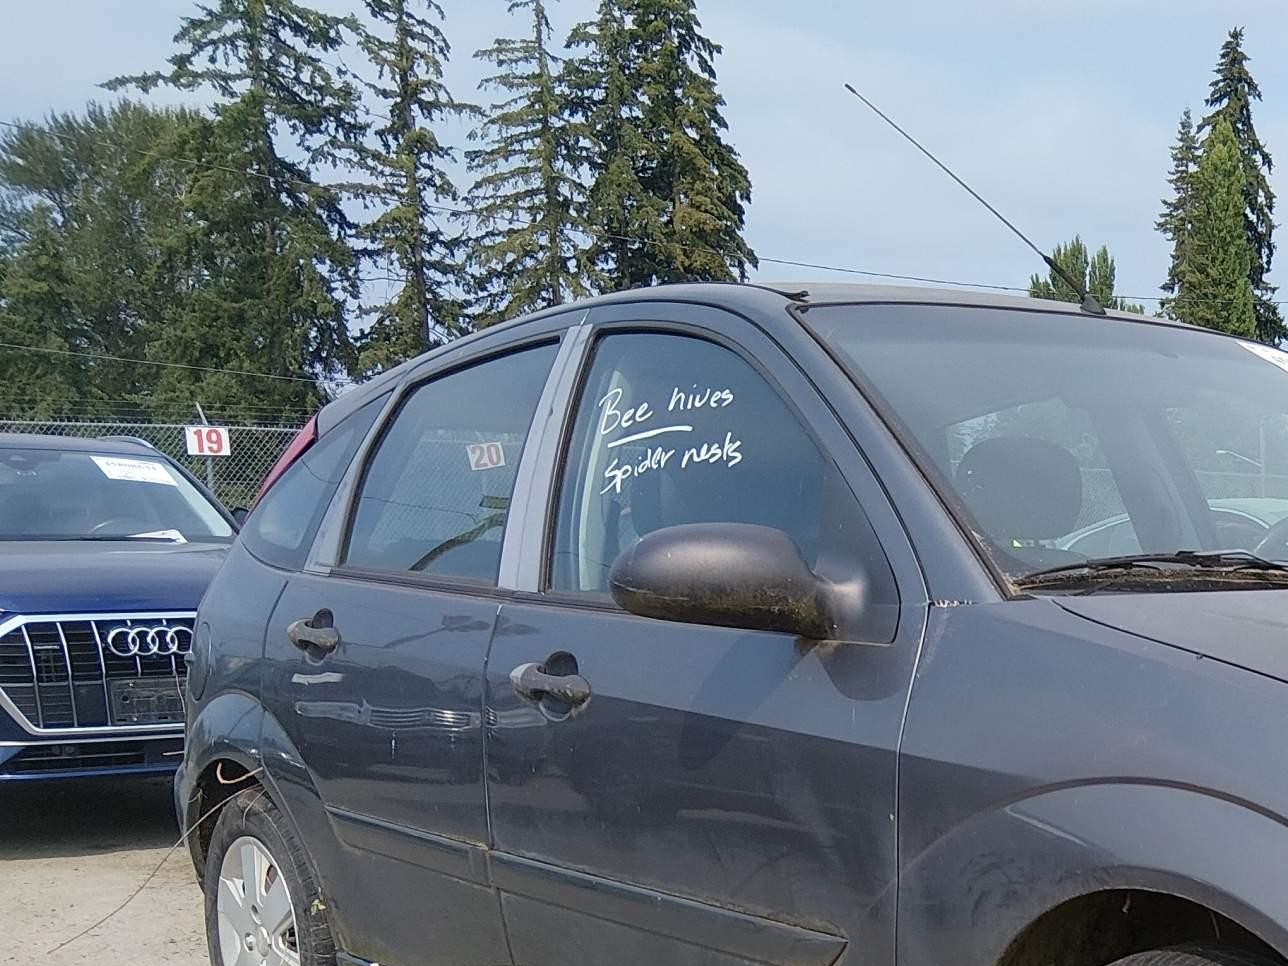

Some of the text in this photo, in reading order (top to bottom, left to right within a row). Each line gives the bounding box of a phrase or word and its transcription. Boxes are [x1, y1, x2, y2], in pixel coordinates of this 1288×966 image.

[599, 384, 734, 435] Bee hives
[193, 429, 223, 454] 19
[470, 443, 502, 468] 20
[681, 432, 743, 468] nests
